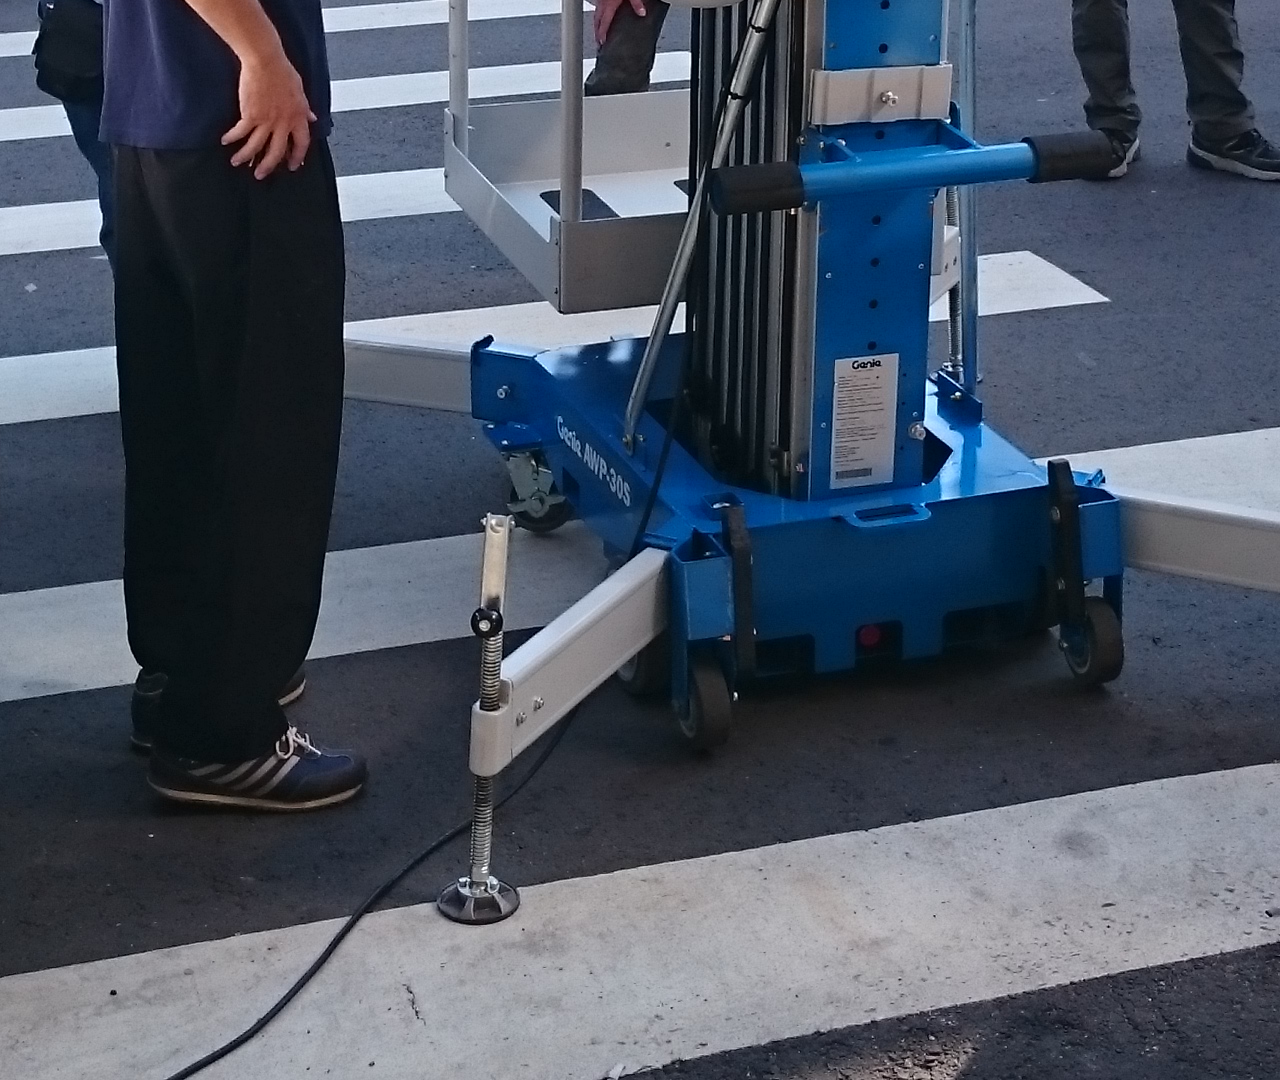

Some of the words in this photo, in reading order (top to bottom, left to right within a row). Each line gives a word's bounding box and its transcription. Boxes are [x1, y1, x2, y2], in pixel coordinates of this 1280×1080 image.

[851, 359, 882, 370] Genie
[557, 415, 582, 457] Genie
[583, 442, 631, 507] AWP-30S
